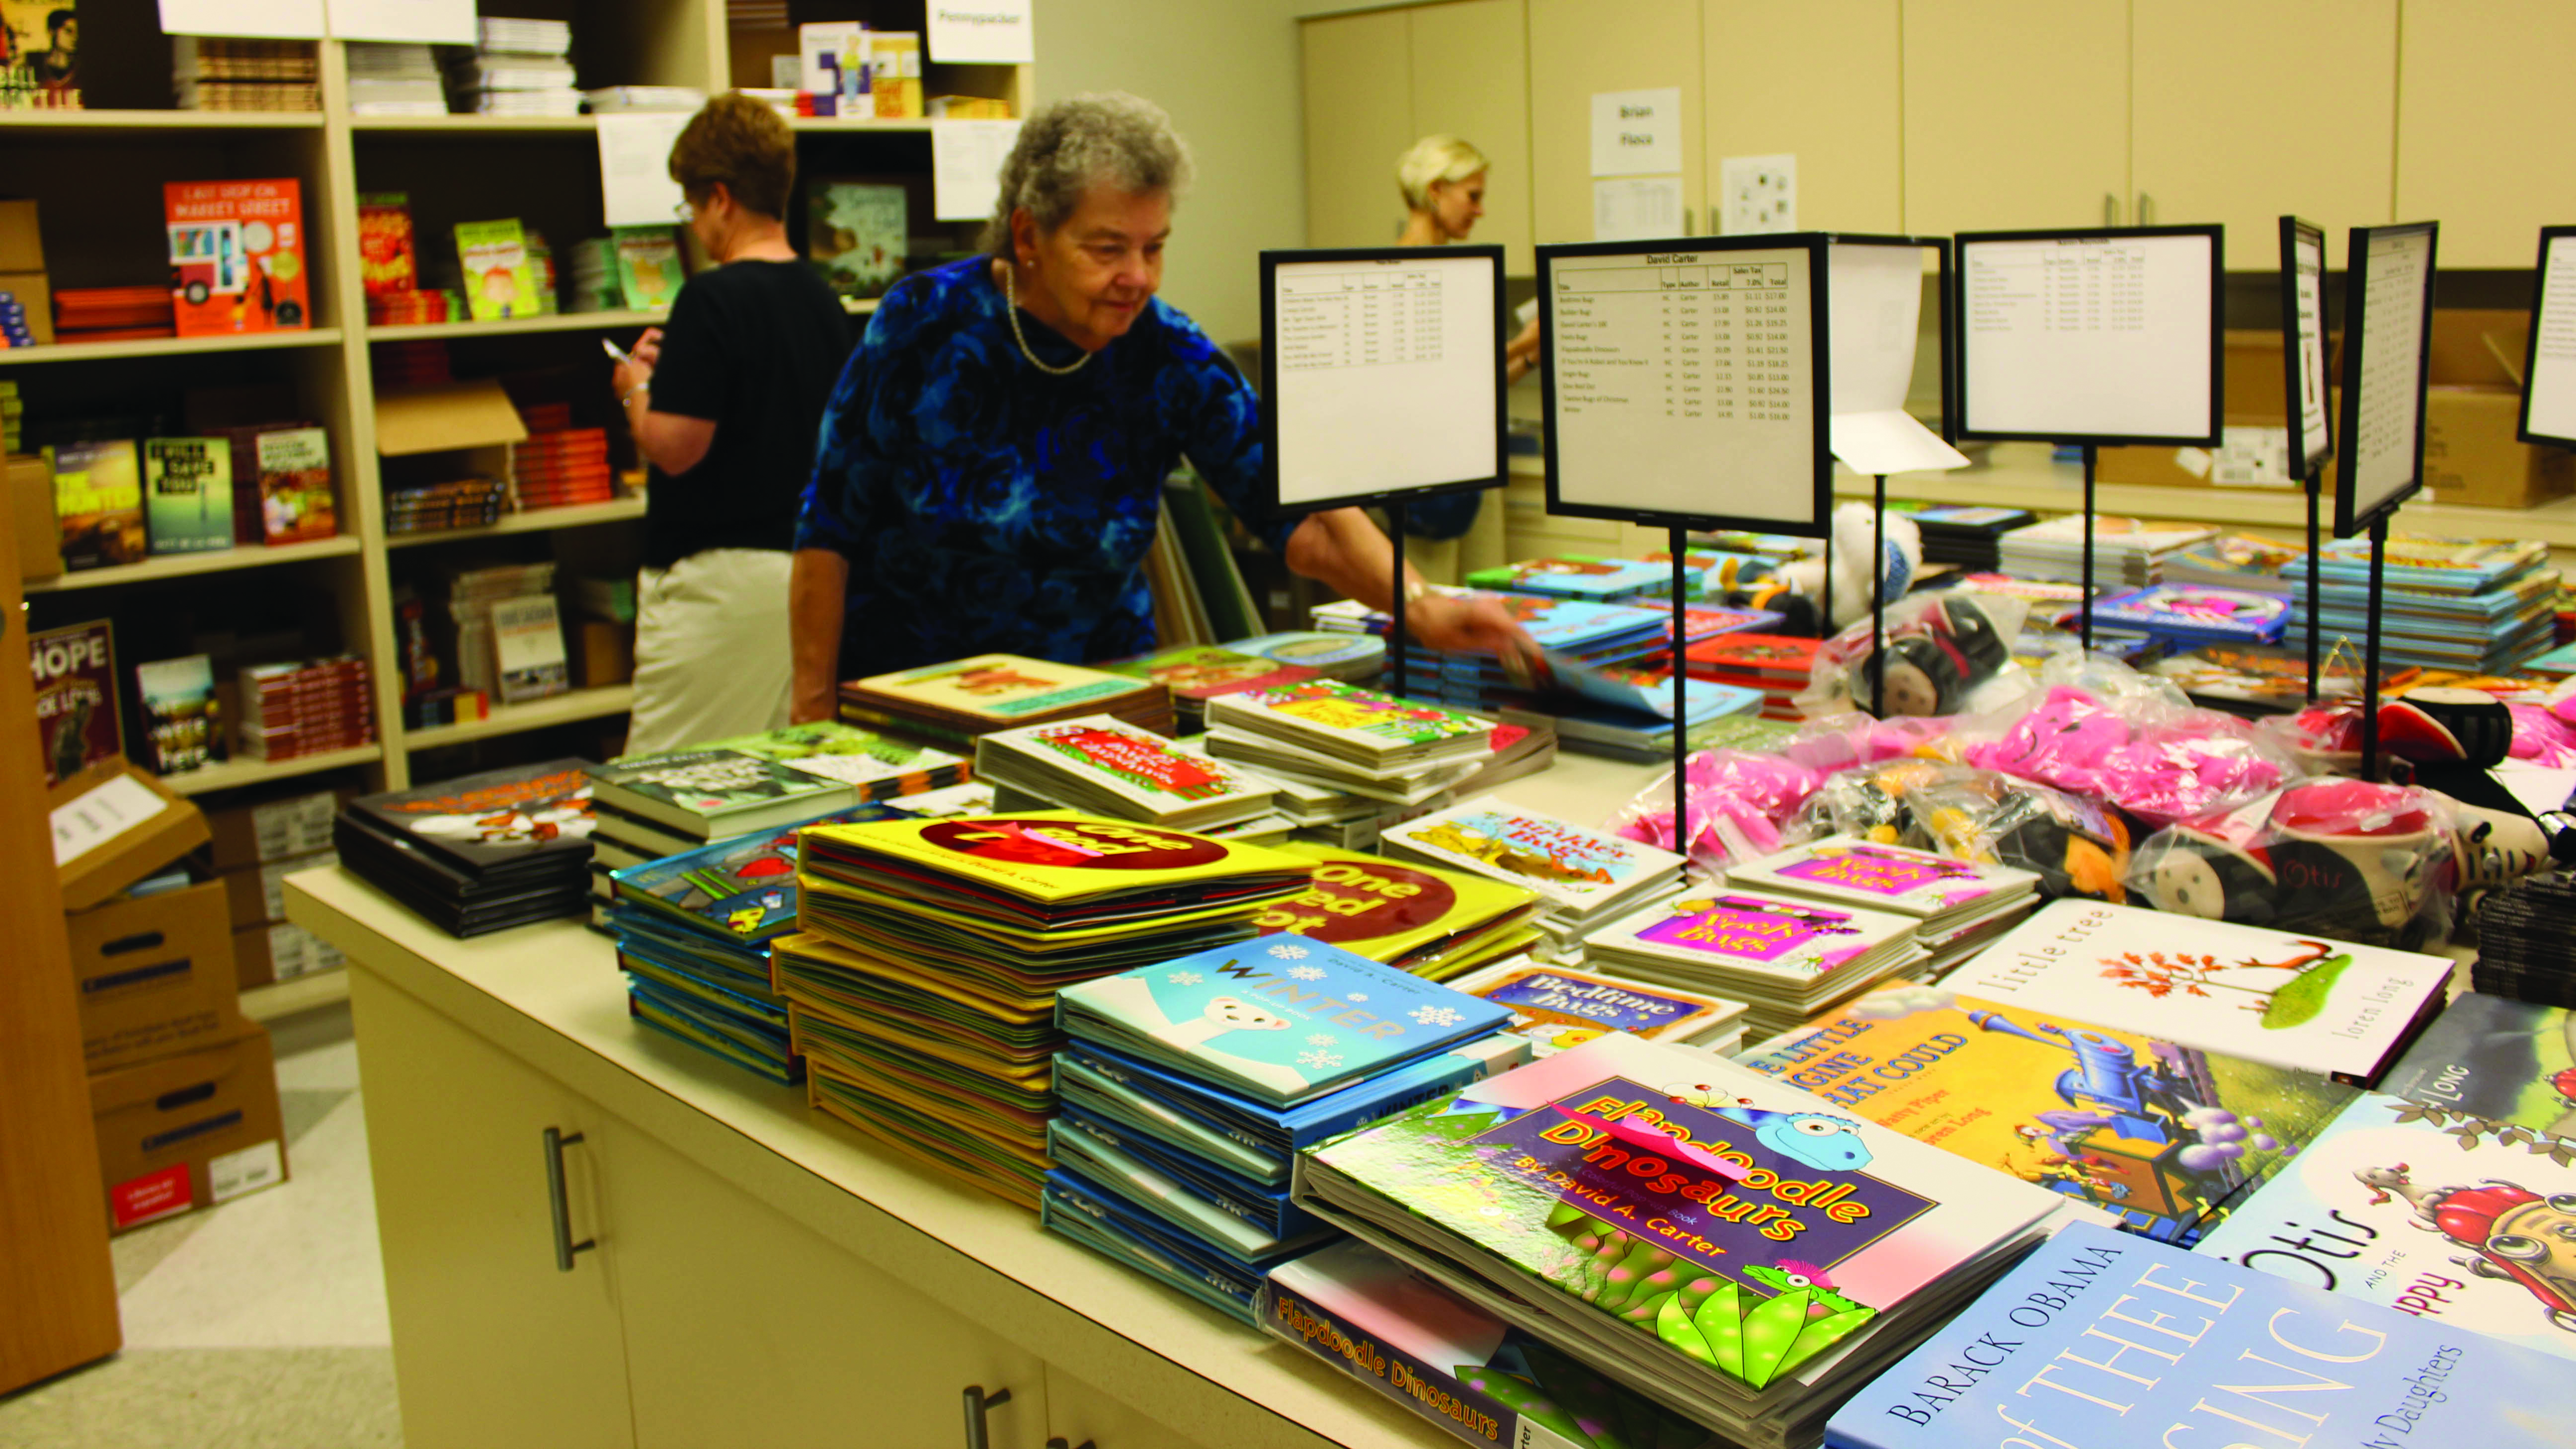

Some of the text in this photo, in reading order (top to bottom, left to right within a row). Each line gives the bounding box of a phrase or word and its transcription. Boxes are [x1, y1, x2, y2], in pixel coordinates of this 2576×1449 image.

[1620, 105, 1653, 119] Brian
[1647, 253, 1698, 264] David Carter
[153, 719, 207, 739] were
[158, 745, 208, 772] here
[1075, 823, 1193, 851] One
[1506, 829, 1593, 860] Bugs
[1507, 817, 1635, 858] Builder
[1311, 864, 1422, 899] One
[1809, 867, 1895, 890] Bugs
[2283, 859, 2344, 888] Otis
[1253, 909, 1328, 936] ot
[1293, 891, 1387, 917] ed
[1673, 924, 1772, 954] Bugs
[1977, 910, 2114, 992] little tree
[1327, 957, 1365, 973] David
[1381, 978, 1422, 995] Carter
[1524, 972, 1676, 1015] Bedtime
[1216, 959, 1406, 1041] WINTER
[1285, 1007, 1312, 1021] BOOK
[1533, 988, 1622, 1018] Bugs
[2331, 1007, 2382, 1041] loren
[2361, 976, 2415, 1004] long
[1788, 1018, 1873, 1064] LITTLE
[1782, 1050, 1874, 1092] GINE
[1821, 1034, 1968, 1110] HAT COULD
[2417, 1063, 2471, 1102] LONG
[1911, 1089, 1951, 1116] Piper
[1922, 1107, 1993, 1147] oren Long
[1574, 1095, 1872, 1226] Flapdoodle
[1538, 1118, 1809, 1244] Dinosaurs
[1514, 1155, 1727, 1258] By David A. Carter
[1667, 1208, 1698, 1226] Book
[2240, 1208, 2379, 1291] Otis
[2364, 1249, 2407, 1290] AND THE
[2390, 1272, 2466, 1317] uppy
[1886, 1246, 2124, 1428] BARACK OBAMA
[2015, 1262, 2246, 1418] THEE
[1278, 1297, 1499, 1442] Flapdoodle Dinosaurs
[2374, 1344, 2464, 1435] Daughters
[1518, 1425, 1532, 1449] rter
